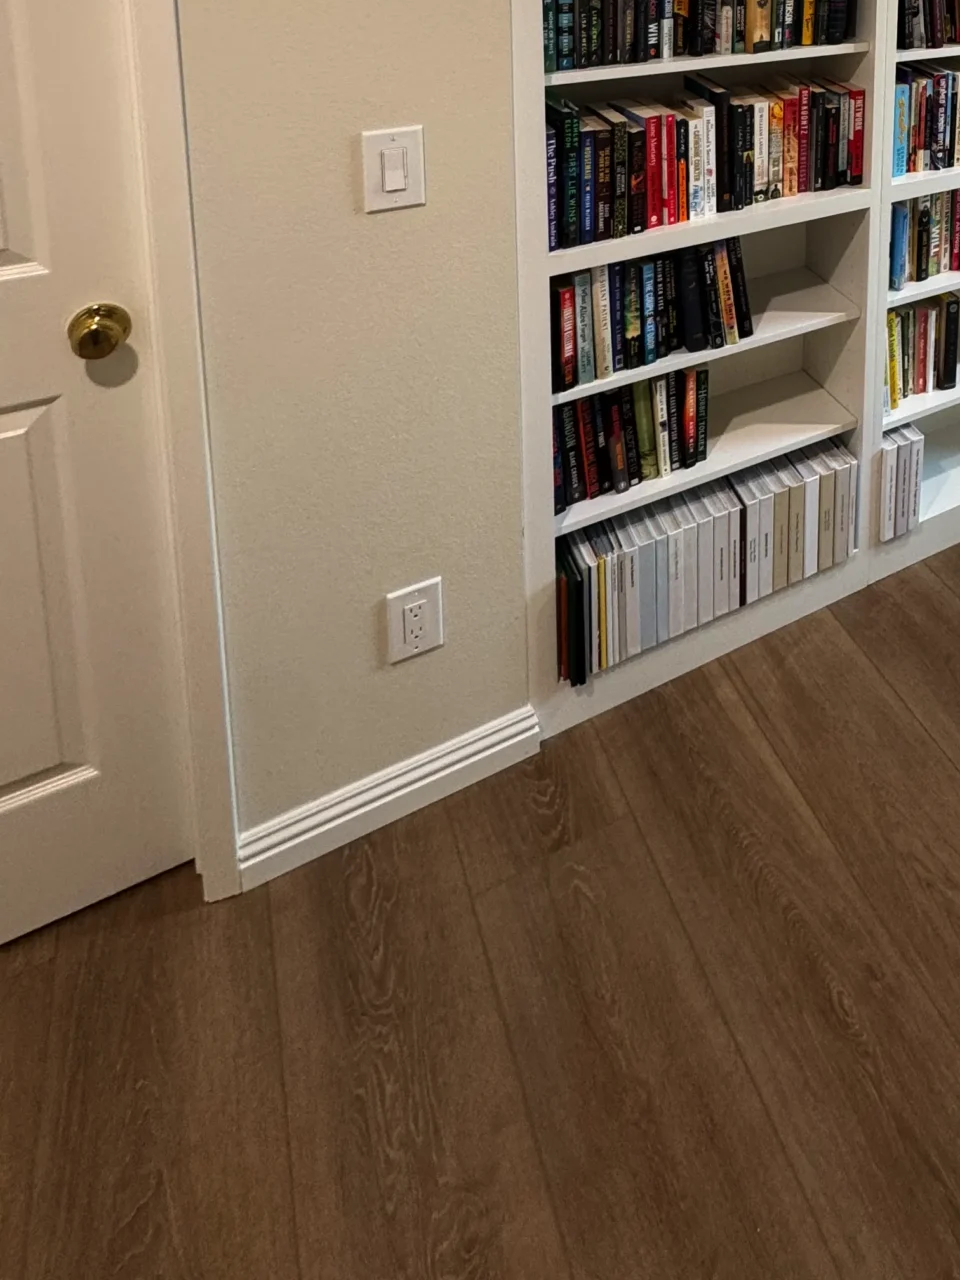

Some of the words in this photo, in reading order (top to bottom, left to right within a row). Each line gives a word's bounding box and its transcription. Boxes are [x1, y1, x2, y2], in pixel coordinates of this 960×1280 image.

[665, 0, 673, 17] COBEN
[648, 23, 658, 45] WIN
[855, 100, 863, 131] NETWORK
[547, 137, 556, 157] The
[548, 159, 557, 183] Push
[568, 153, 576, 177] FIRST
[584, 147, 592, 180] HOUSEMAID
[568, 180, 576, 195] LIE
[568, 198, 576, 223] WINS
[931, 224, 940, 256] WILL
[645, 280, 653, 292] THE
[724, 269, 728, 280] we
[645, 293, 653, 316] COUPLE
[646, 317, 654, 331] NEXT
[647, 333, 655, 350] DOOR
[698, 390, 707, 417] HOBBIT
[562, 406, 576, 449] ABANDON
